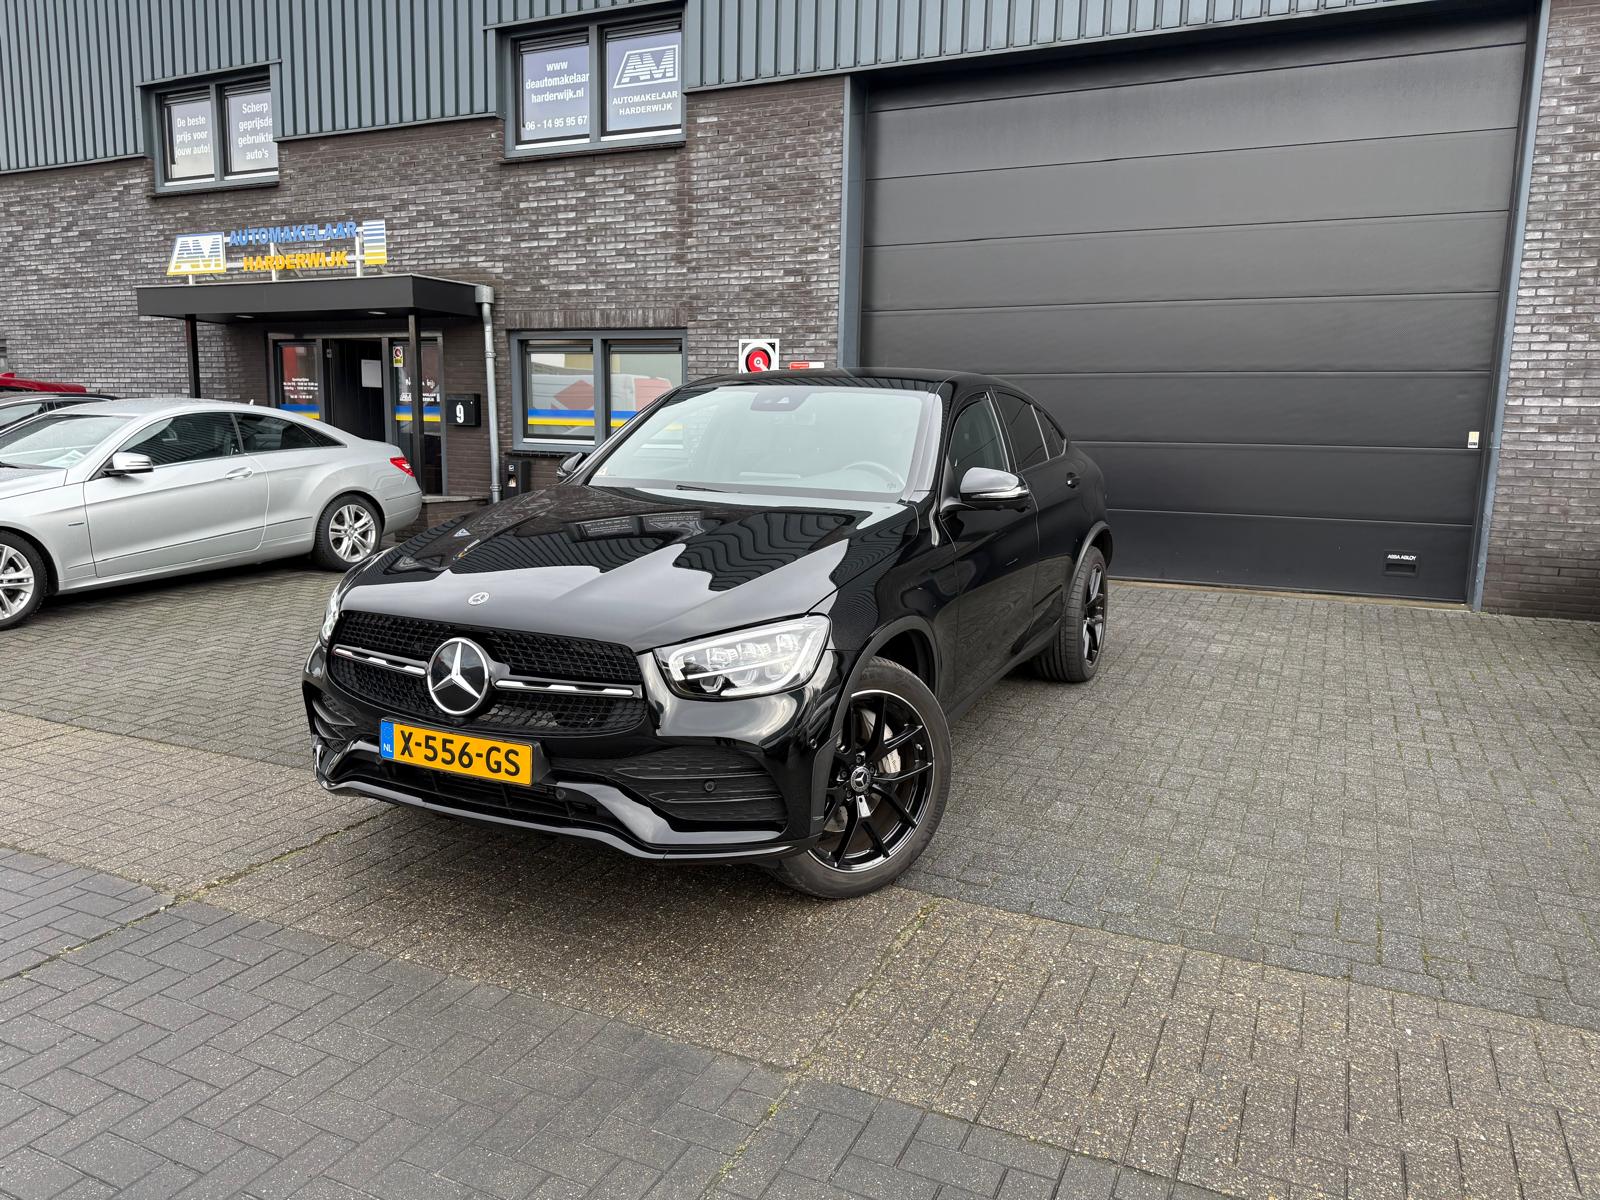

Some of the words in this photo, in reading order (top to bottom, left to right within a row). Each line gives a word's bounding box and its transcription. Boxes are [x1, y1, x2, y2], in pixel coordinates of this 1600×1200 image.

[547, 60, 568, 71] www
[526, 72, 589, 89] deautomakelaar
[532, 88, 584, 104] harderwijk.nl
[612, 90, 678, 105] AUTOMAKELAAR
[242, 102, 268, 114] Scherp
[619, 102, 673, 115] HARDERWIJK
[177, 118, 186, 127] De
[187, 115, 206, 126] beste
[239, 117, 273, 132] geprijsde
[526, 121, 536, 130] 06
[543, 119, 552, 129] 14
[554, 118, 565, 128] 95
[566, 117, 576, 126] 95
[578, 115, 588, 125] 67
[176, 132, 191, 144] prijs
[192, 130, 208, 140] voor
[238, 132, 273, 148] gebruikte
[175, 146, 192, 158] jouw
[193, 144, 210, 154] auto!
[246, 148, 269, 160] auto's
[229, 221, 357, 247] AUTOMAKELAAR
[243, 251, 349, 272] HARDERWIJK
[456, 404, 464, 424] 9
[383, 743, 393, 753] NL
[400, 729, 521, 777] X-556-GS
